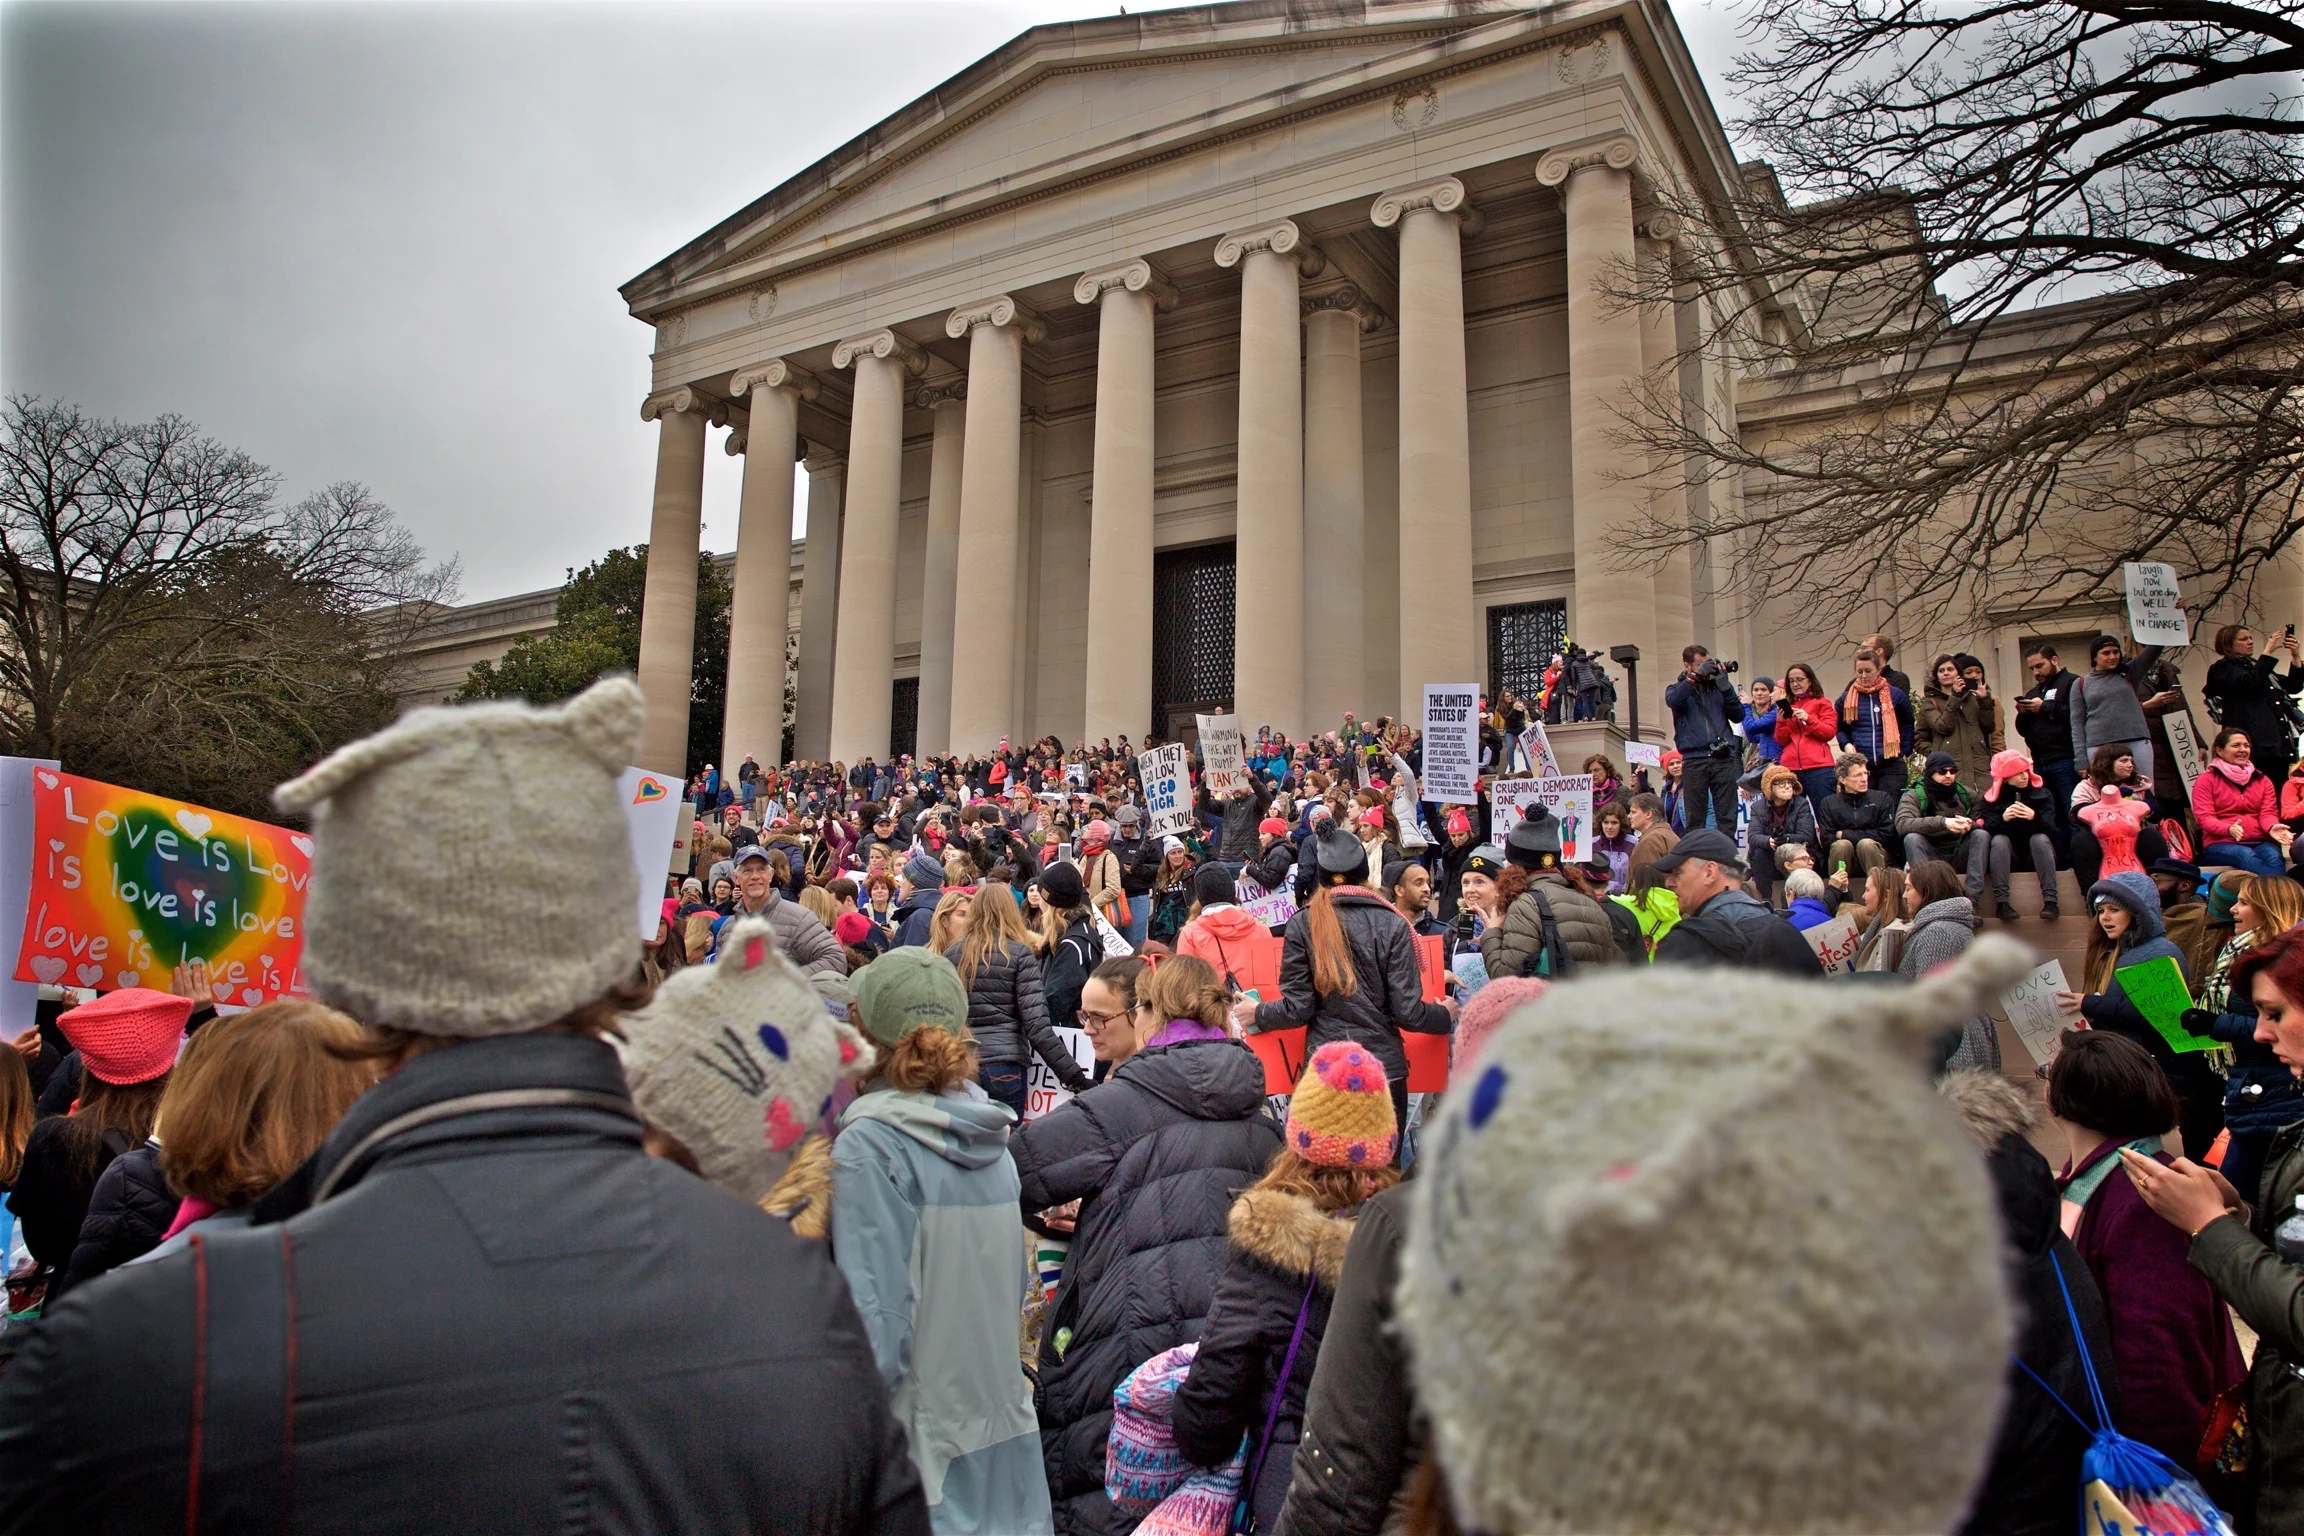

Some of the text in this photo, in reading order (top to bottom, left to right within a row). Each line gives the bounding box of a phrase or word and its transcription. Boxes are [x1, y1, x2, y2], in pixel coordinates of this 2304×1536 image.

[2144, 578, 2160, 586] now
[2133, 587, 2147, 597] but
[2164, 588, 2177, 600] day
[2142, 599, 2167, 608] WE'LL
[2148, 610, 2159, 618] be
[2136, 619, 2145, 627] IN
[1429, 694, 1472, 707] THE UNITED
[1206, 717, 1211, 727] IF
[1428, 709, 1467, 722] STATES OF
[1211, 728, 1238, 741] WARMING
[2172, 719, 2194, 759] SUCK
[1155, 744, 1182, 765] THEY
[1222, 744, 1237, 755] WHY
[1210, 758, 1235, 769] TRUMP
[1145, 770, 1154, 785] GO
[1145, 779, 1176, 800] WE GO
[1543, 778, 1592, 793] DEMOCRACY
[1497, 795, 1515, 805] ONE
[1169, 810, 1191, 828] YOU
[1494, 809, 1506, 818] AT
[2097, 810, 2126, 820] EAT
[64, 786, 179, 862] Love
[200, 837, 230, 872] is
[1504, 820, 1510, 831] A
[2104, 836, 2126, 845] THE
[2106, 854, 2140, 868] RICH
[48, 840, 294, 938] is love is love
[34, 901, 108, 961] love
[128, 933, 152, 970] is
[180, 941, 248, 984] love
[260, 956, 281, 990] is
[1827, 964, 1838, 973] is
[2006, 970, 2057, 1005] love
